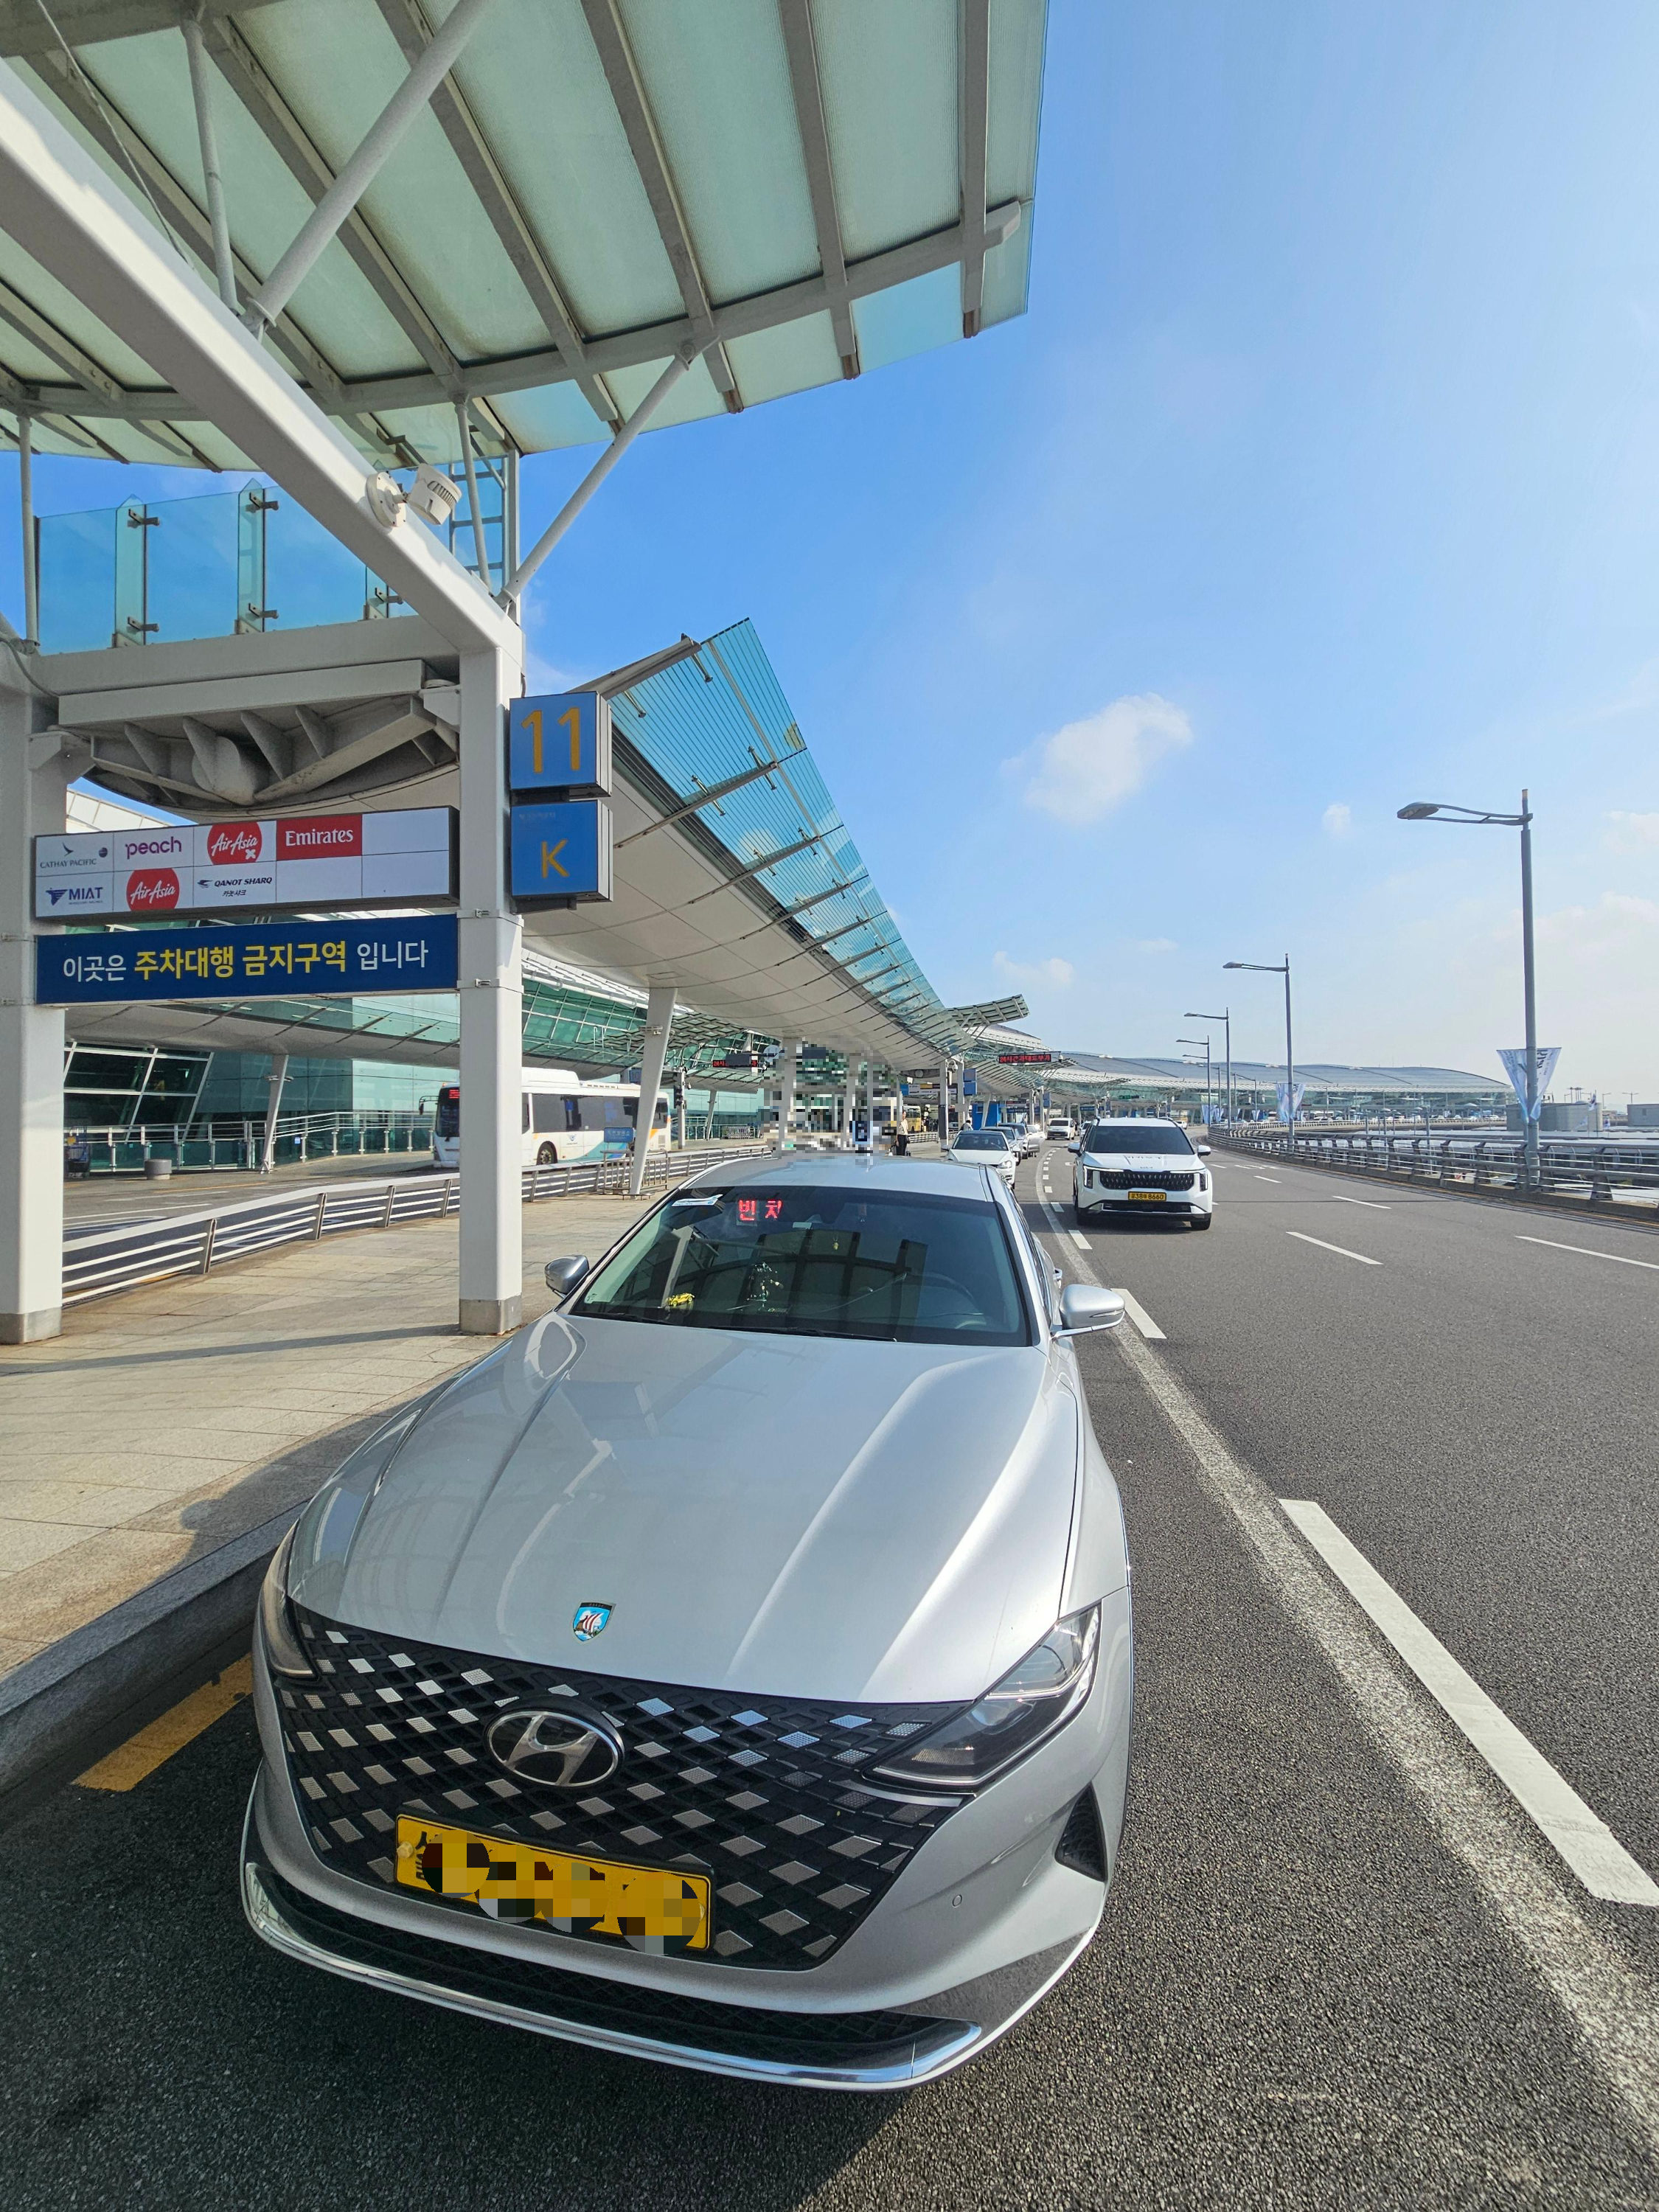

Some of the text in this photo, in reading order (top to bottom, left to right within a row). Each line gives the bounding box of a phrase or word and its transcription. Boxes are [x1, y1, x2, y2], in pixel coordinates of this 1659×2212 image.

[520, 706, 580, 773] 11
[125, 835, 182, 860] peach
[211, 832, 258, 857] AirAsia
[285, 828, 354, 846] Emirates
[40, 858, 97, 869] CATHAY PACIFIC
[540, 838, 570, 879] K
[69, 886, 103, 900] MIAT
[130, 880, 176, 905] AirAsia
[214, 876, 273, 888] QANOT SHARQ
[63, 939, 429, 982] 이곳은 주차대행 금지구역 입니다
